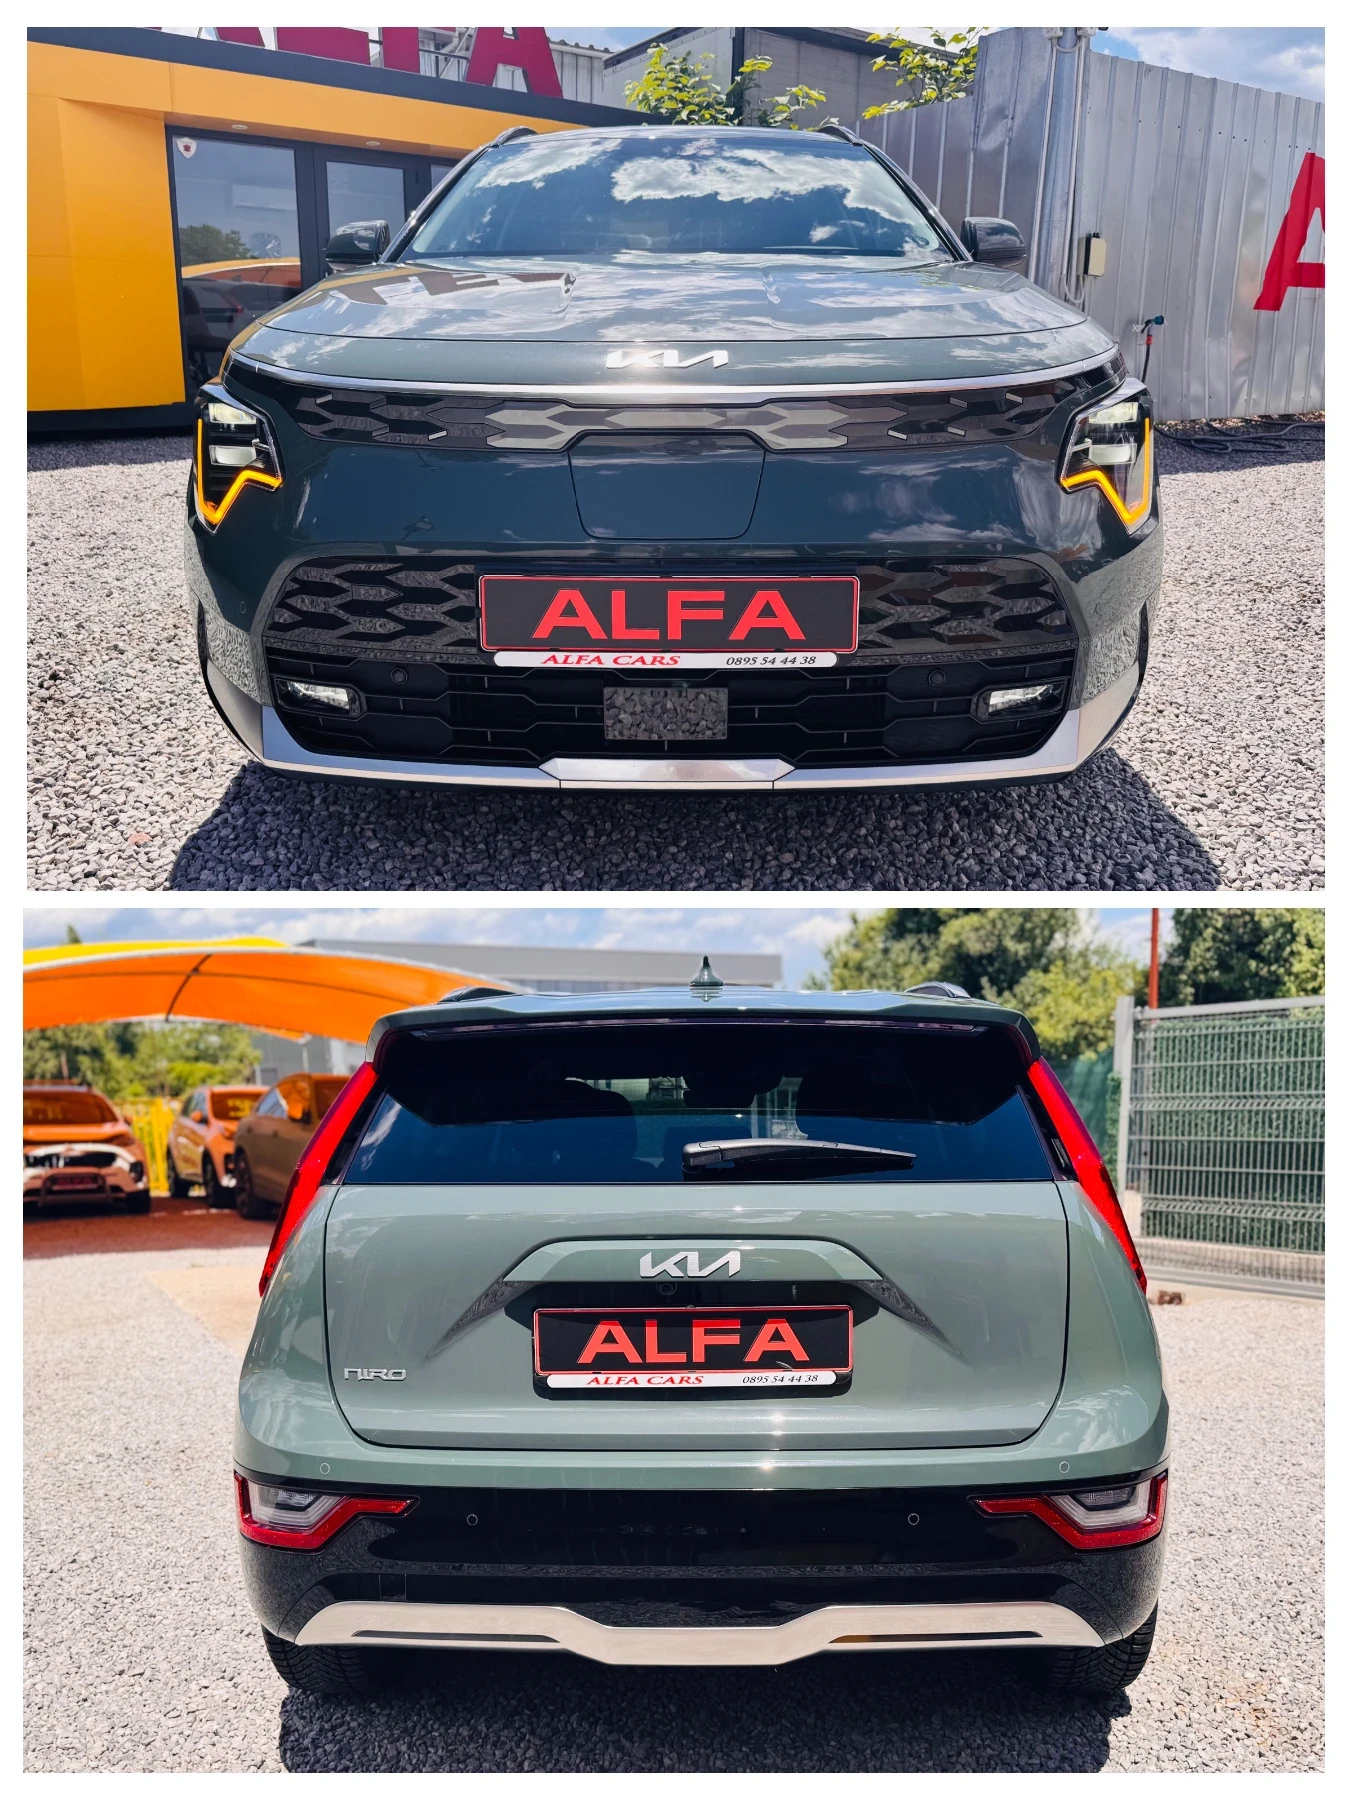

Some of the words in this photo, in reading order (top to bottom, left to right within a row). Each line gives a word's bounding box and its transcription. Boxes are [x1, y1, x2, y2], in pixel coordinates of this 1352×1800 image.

[606, 349, 728, 369] KIA
[531, 588, 806, 640] ALFA
[540, 654, 605, 665] ALFA
[612, 655, 681, 666] CARS
[725, 656, 758, 666] 0895
[759, 656, 777, 665] 54
[780, 656, 797, 665] 44
[799, 656, 817, 665] 38
[640, 1251, 741, 1278] KIA
[577, 1319, 810, 1364] ALFA
[344, 1368, 407, 1381] NIRO
[586, 1376, 640, 1385] ALFA
[646, 1375, 704, 1385] CARS
[742, 1375, 769, 1384] 0895
[771, 1375, 785, 1384] 54
[788, 1375, 802, 1383] 44
[804, 1374, 819, 1383] 38
